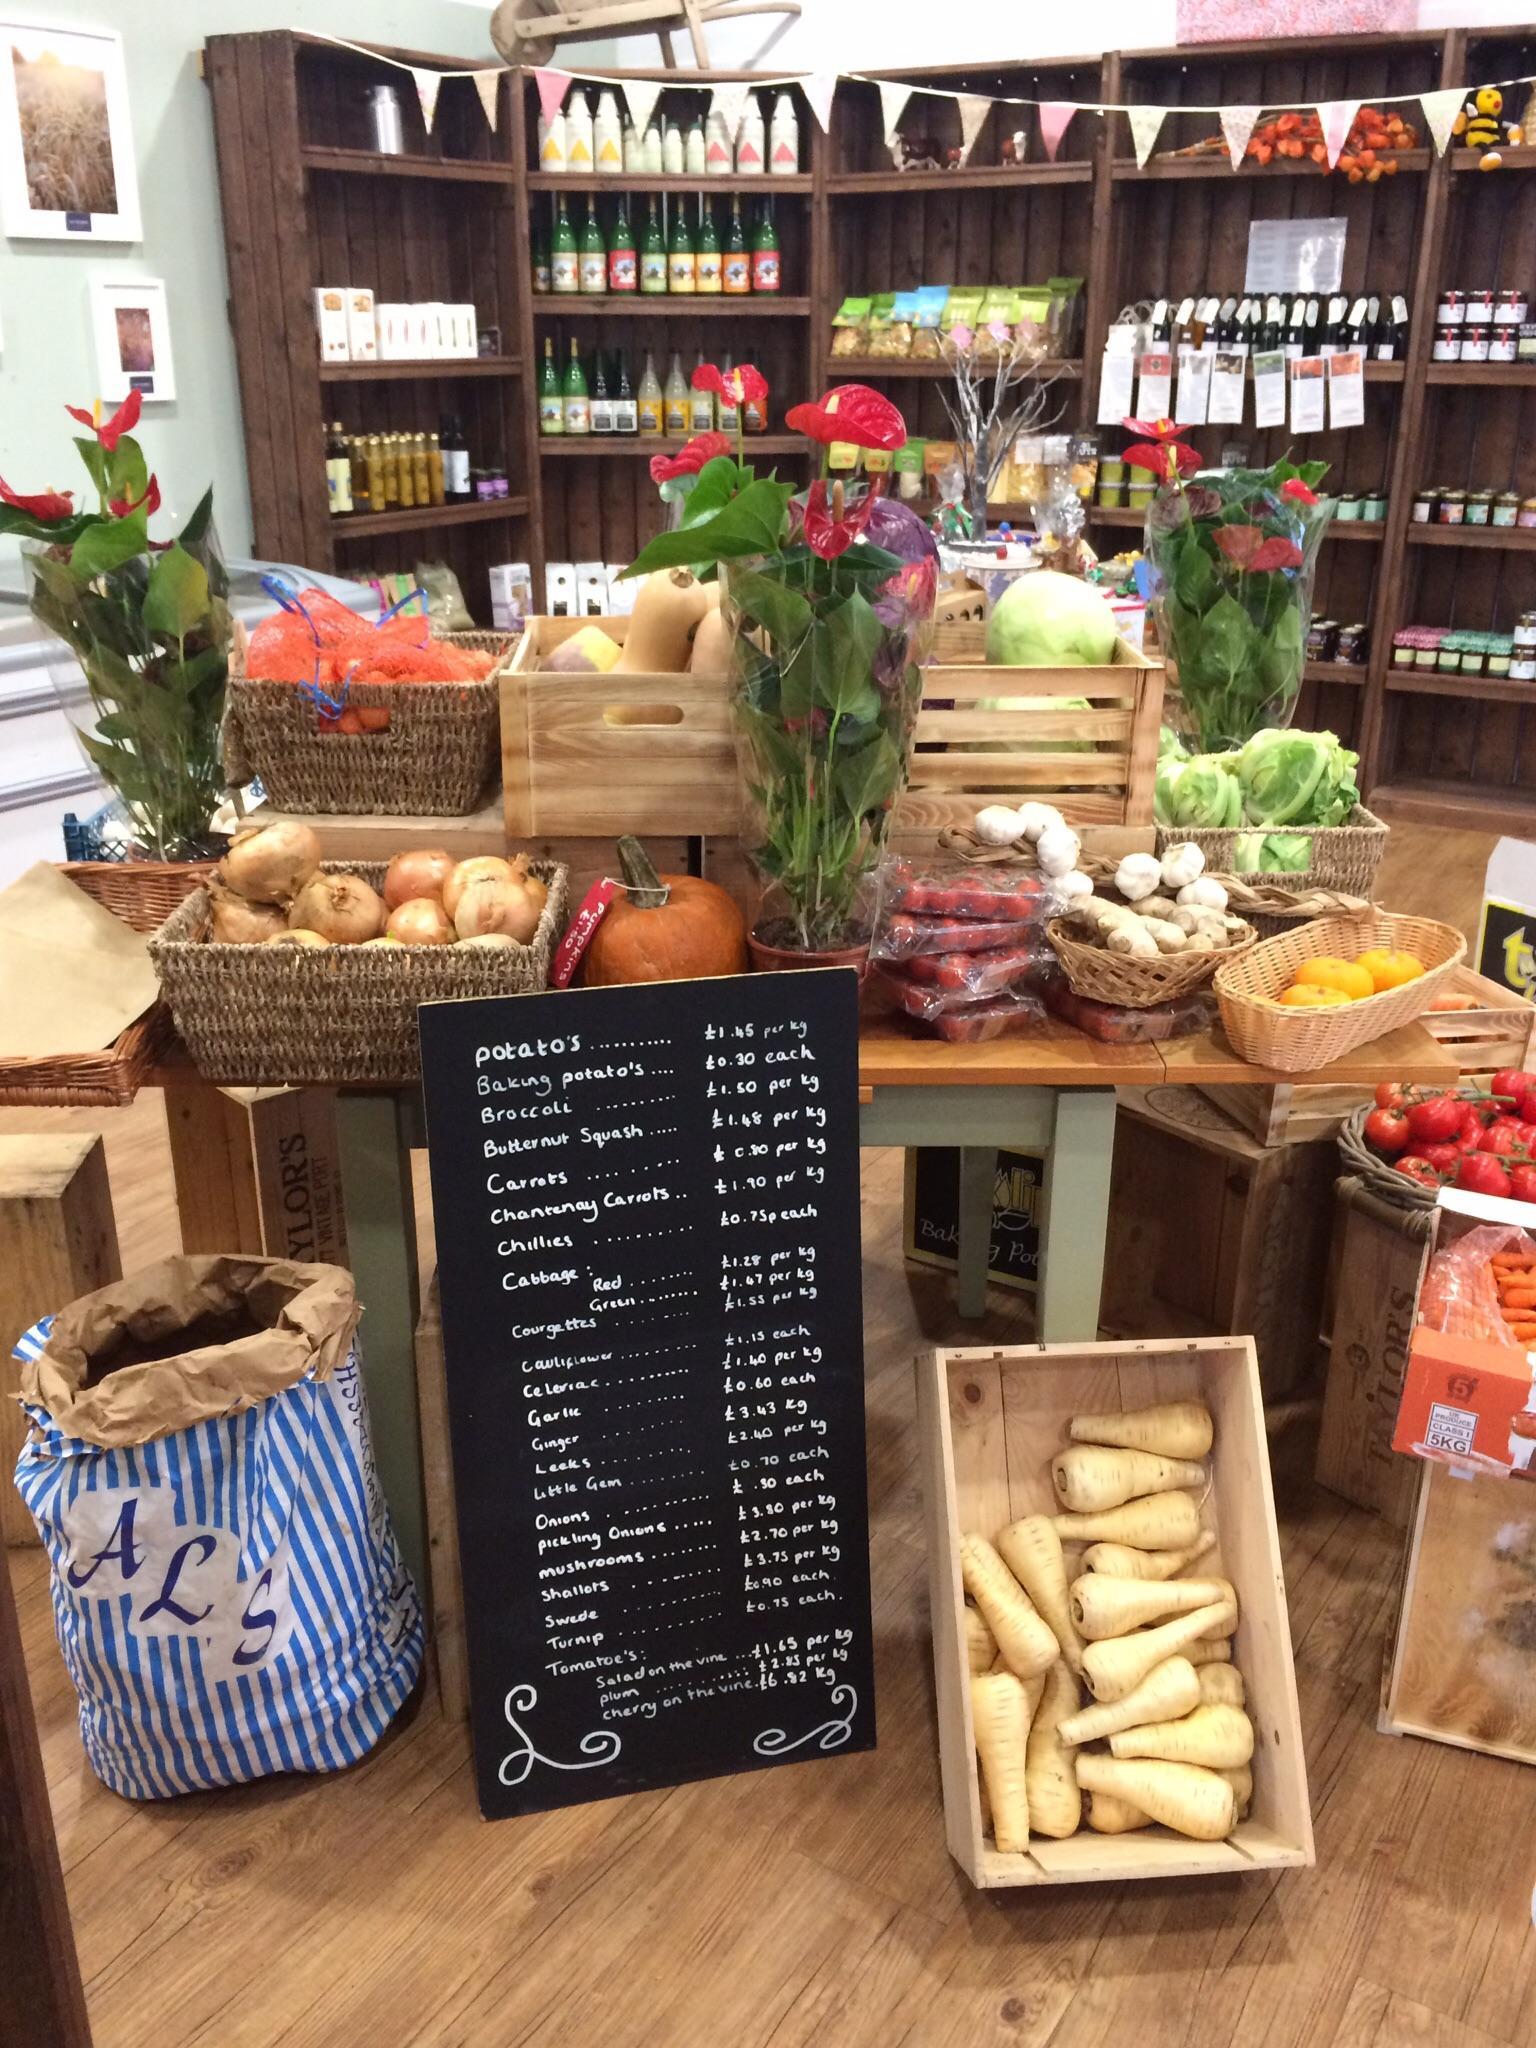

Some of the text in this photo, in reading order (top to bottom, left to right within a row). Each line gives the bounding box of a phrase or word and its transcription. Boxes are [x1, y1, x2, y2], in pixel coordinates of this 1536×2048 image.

[705, 1023, 754, 1040] £1.45
[764, 1025, 784, 1038] per
[790, 1021, 807, 1039] kg
[477, 1075, 552, 1096] Baking
[706, 1052, 755, 1070] £0.30
[765, 1044, 816, 1063] each
[481, 1074, 819, 1124] Broccoli £1.50 per kg
[484, 1106, 826, 1158] Butternut Squash £1.48 per kg
[487, 1171, 568, 1194] Carrots
[776, 1142, 798, 1157] per
[807, 1137, 826, 1154] kg
[604, 1187, 670, 1207] Carrots
[714, 1176, 766, 1194] £1.90
[776, 1170, 796, 1189] per
[807, 1166, 824, 1183] kg
[278, 1132, 316, 1263] YLOR'S
[781, 1204, 817, 1220] each
[589, 1297, 635, 1312] Green
[769, 1271, 791, 1285] per
[797, 1268, 814, 1282] kg
[593, 1247, 815, 1292] Red £1.28 per kg
[773, 1291, 792, 1304] per
[799, 1287, 817, 1299] kg
[773, 1324, 811, 1339] each
[722, 1352, 766, 1370] £1.40
[775, 1351, 796, 1366] per
[803, 1347, 822, 1363] kg
[528, 1372, 816, 1427] Garlic £0.60 each
[1434, 1412, 1473, 1428] PRODUCE
[532, 1435, 579, 1453] Ginger
[785, 1399, 807, 1414] kg
[536, 1458, 591, 1474] Leeks
[784, 1424, 804, 1437] per
[811, 1419, 827, 1435] kg
[1430, 1434, 1467, 1453] 5KG
[1432, 1423, 1465, 1437] CLASS
[586, 1476, 622, 1491] Gem
[728, 1455, 779, 1471] £0.70
[789, 1446, 829, 1462] each
[535, 1511, 590, 1530] Onions
[786, 1469, 824, 1485] each
[609, 1522, 666, 1539] Onions
[792, 1500, 813, 1514] per
[818, 1495, 836, 1511] kg
[740, 1528, 788, 1544] £2.70
[793, 1524, 814, 1537] per
[821, 1520, 838, 1535] kg
[744, 1551, 788, 1568] £3.75
[795, 1551, 815, 1564] per
[822, 1545, 840, 1562] kg
[545, 1610, 599, 1628] Swede
[792, 1569, 829, 1583] each
[546, 1632, 604, 1649] Turnip
[746, 1597, 789, 1612] £0.75
[648, 1666, 665, 1676] on
[669, 1660, 693, 1672] the
[696, 1654, 727, 1665] vine
[807, 1635, 829, 1650] per
[835, 1629, 853, 1646] kg
[600, 1689, 639, 1707] plum
[806, 1653, 825, 1667] per
[833, 1648, 848, 1661] kg
[663, 1696, 682, 1707] on
[687, 1688, 715, 1700] the
[718, 1680, 752, 1693] vine
[815, 1667, 835, 1685] kg
